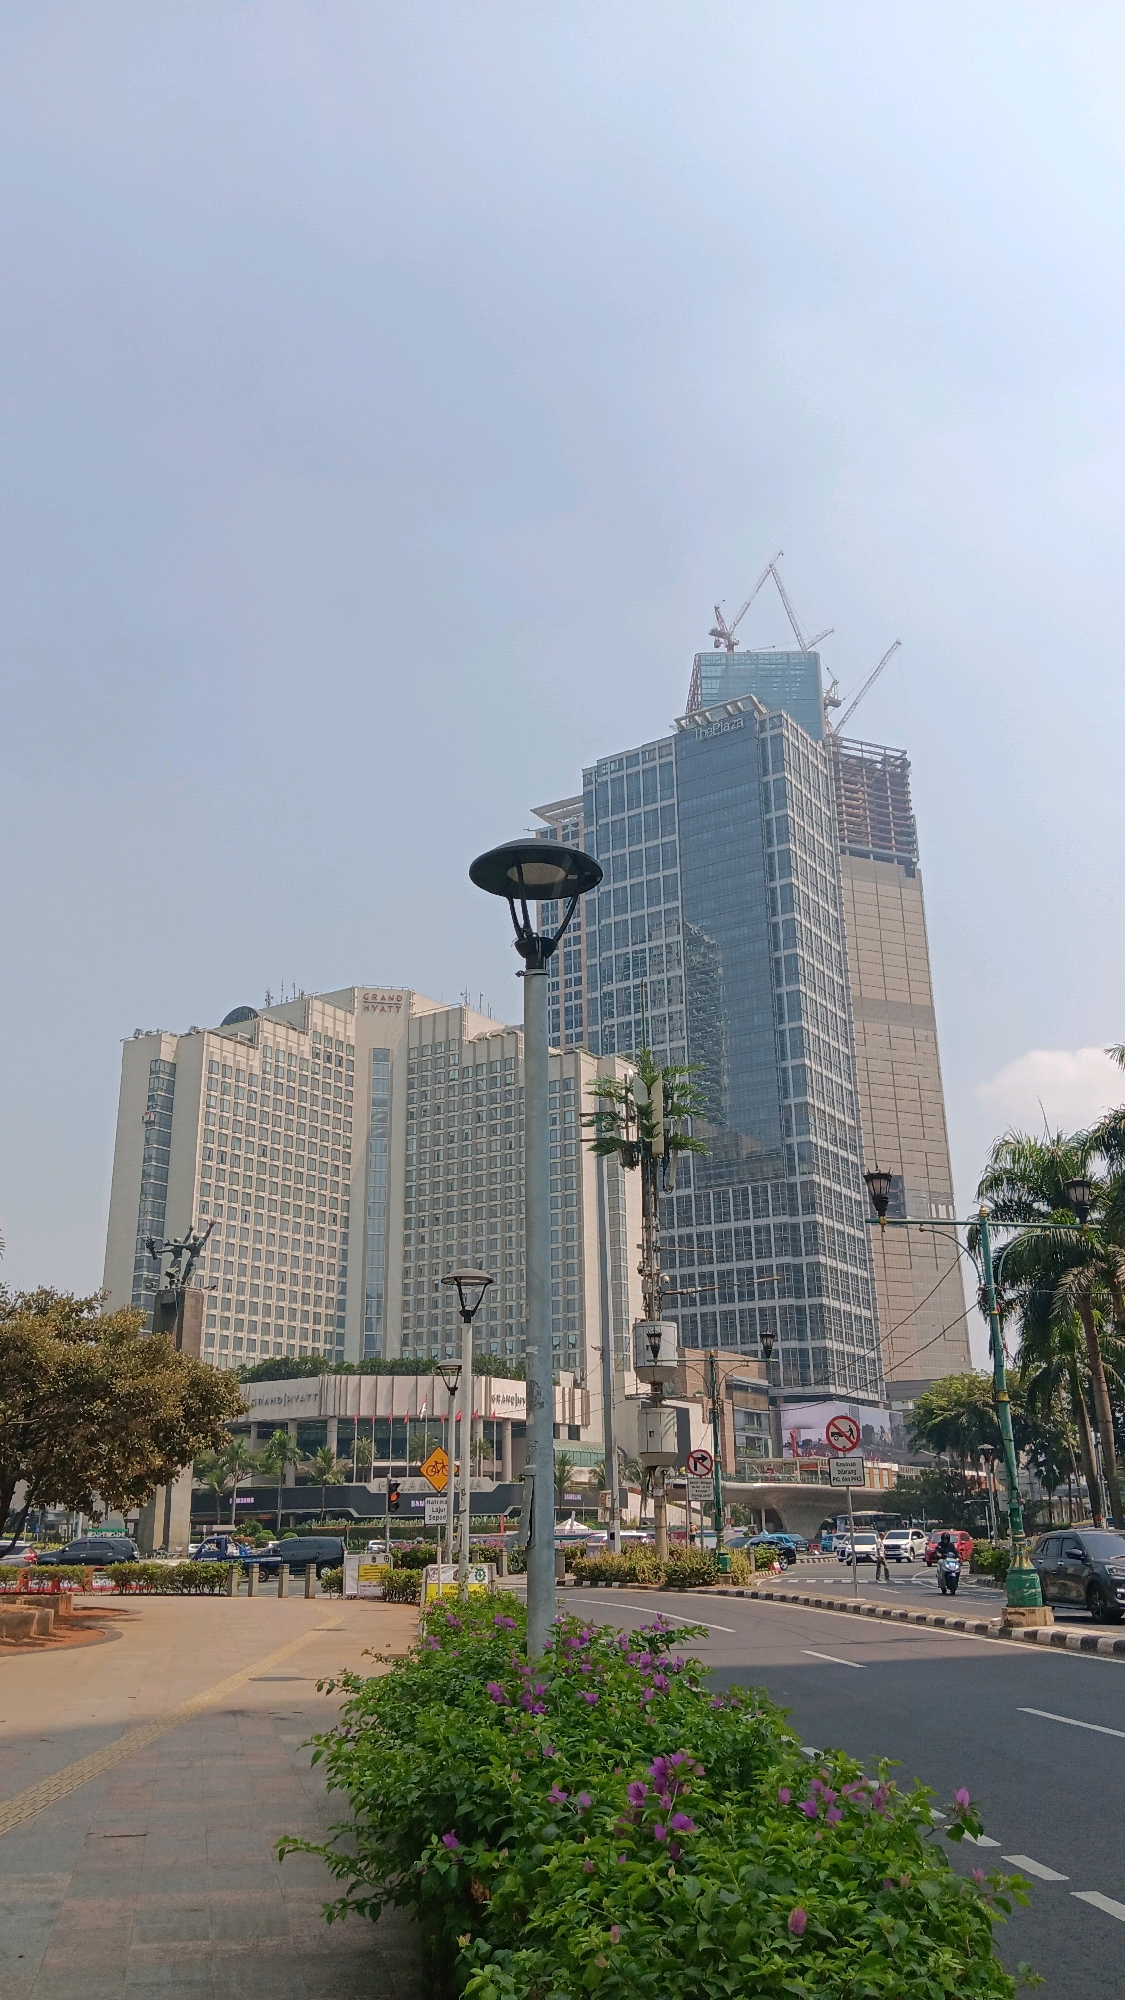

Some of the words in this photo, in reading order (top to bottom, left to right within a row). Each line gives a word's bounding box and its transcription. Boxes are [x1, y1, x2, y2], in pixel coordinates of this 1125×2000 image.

[363, 992, 403, 1002] GRAND
[363, 1004, 401, 1013] HYATT
[286, 1393, 318, 1404] HYATT
[431, 1506, 446, 1514] Lajur
